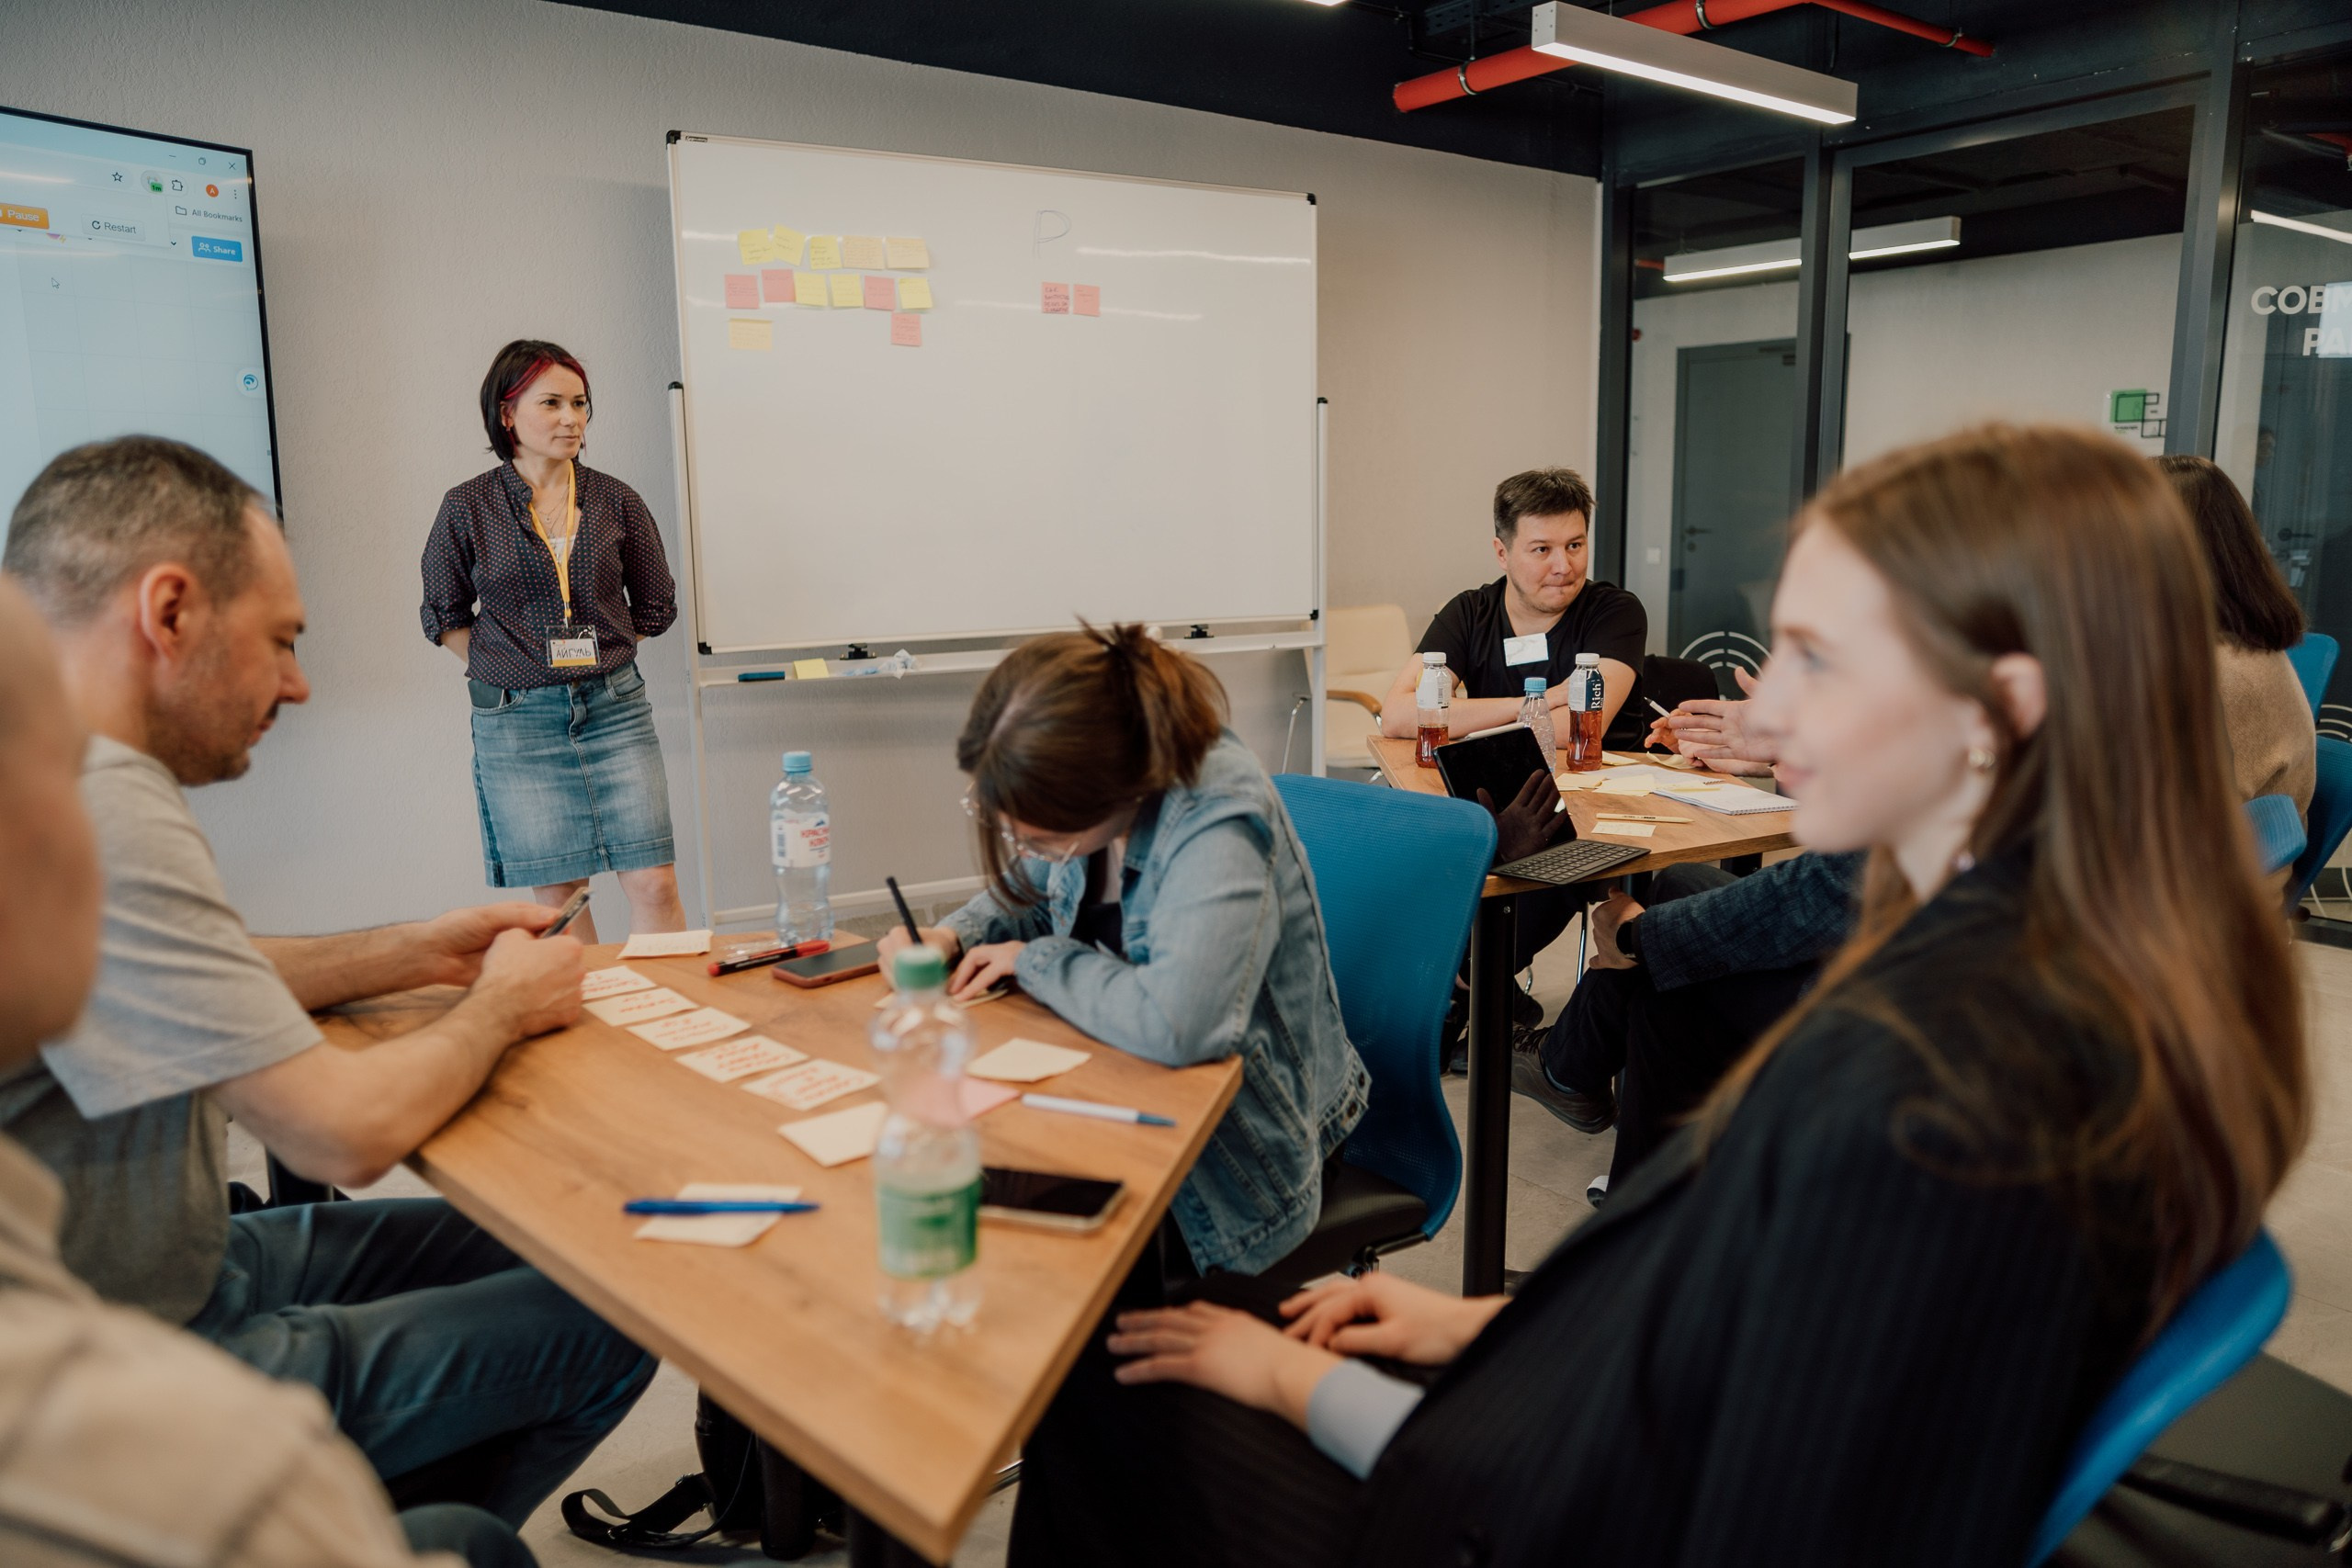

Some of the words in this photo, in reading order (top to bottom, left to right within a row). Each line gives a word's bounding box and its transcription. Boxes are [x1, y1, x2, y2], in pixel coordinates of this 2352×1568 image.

[7, 209, 40, 221] Pause
[203, 210, 243, 222] Bookmarks
[104, 221, 137, 234] Restart
[213, 245, 236, 255] Share
[556, 647, 592, 659] АЙГУЛЬ
[1590, 682, 1601, 708] Rich
